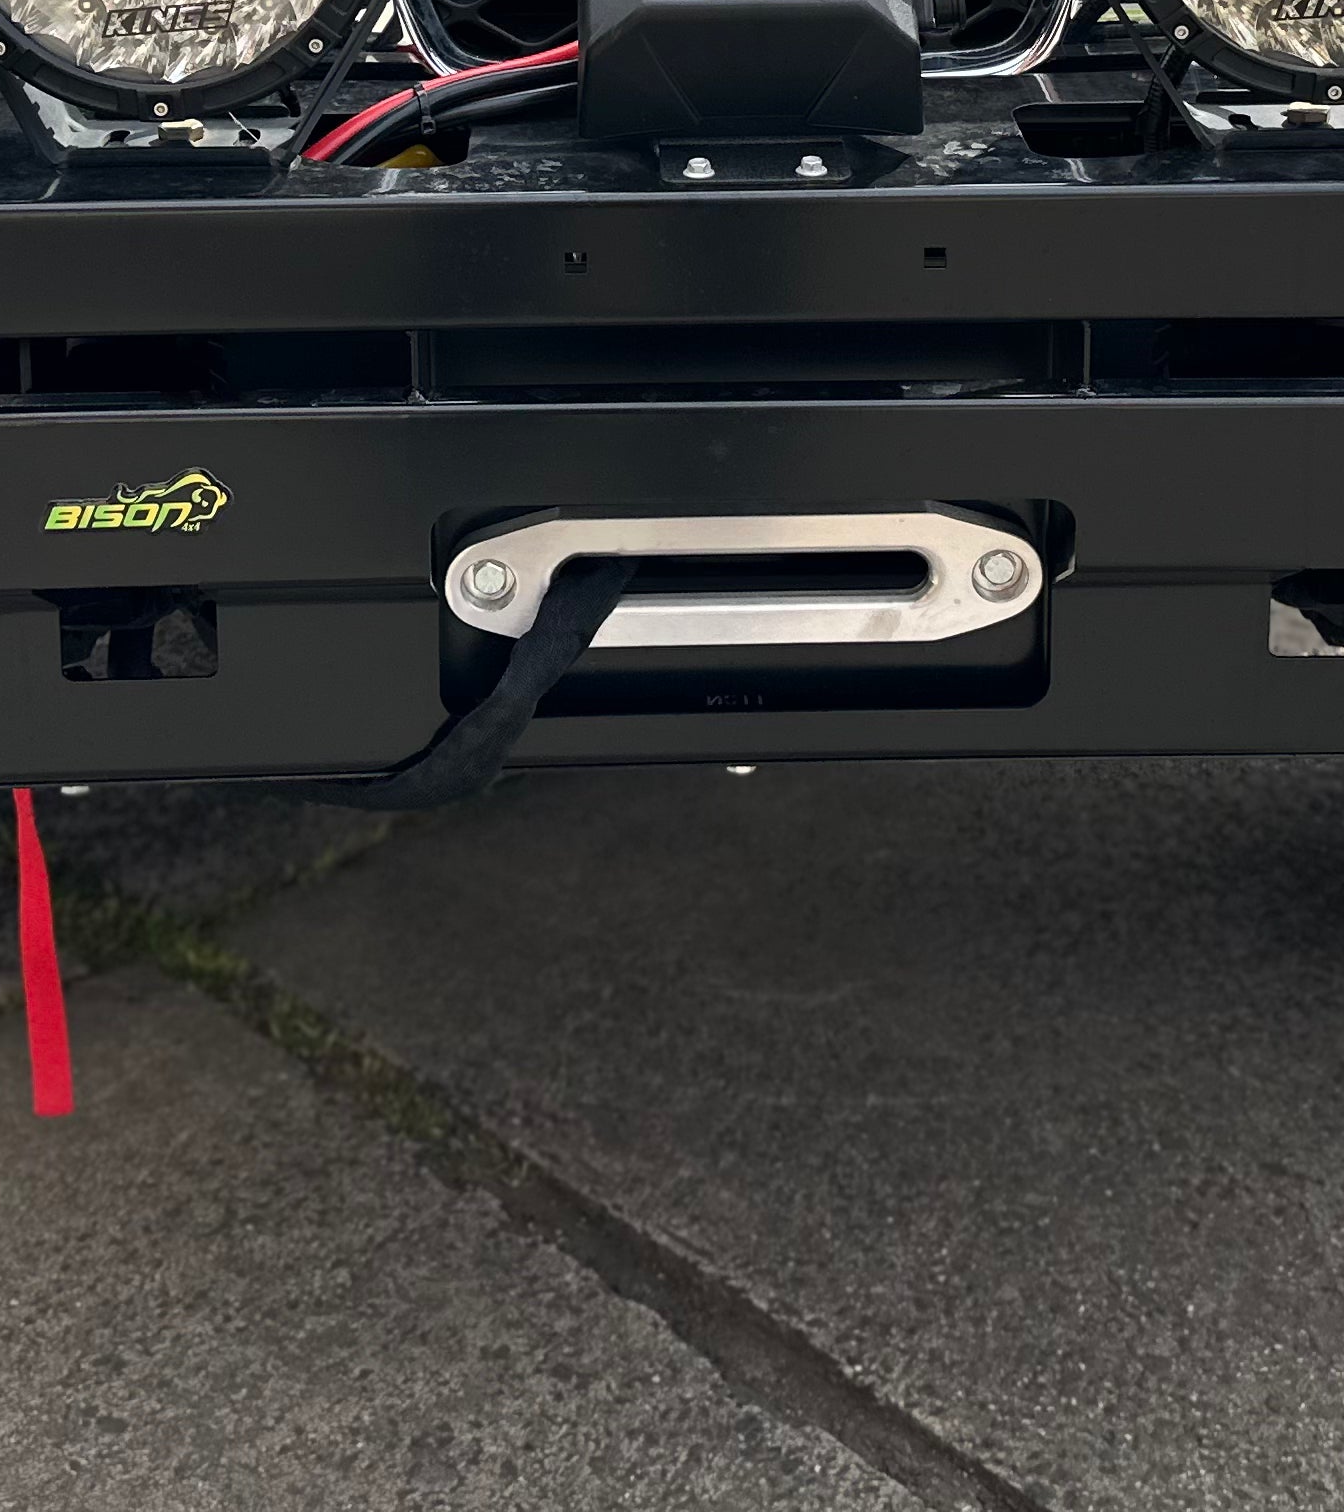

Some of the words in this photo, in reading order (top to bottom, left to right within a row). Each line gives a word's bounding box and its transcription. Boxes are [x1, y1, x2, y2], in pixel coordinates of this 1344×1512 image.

[103, 0, 235, 38] KINGS
[44, 502, 192, 532] BISON
[180, 521, 200, 533] 4x4
